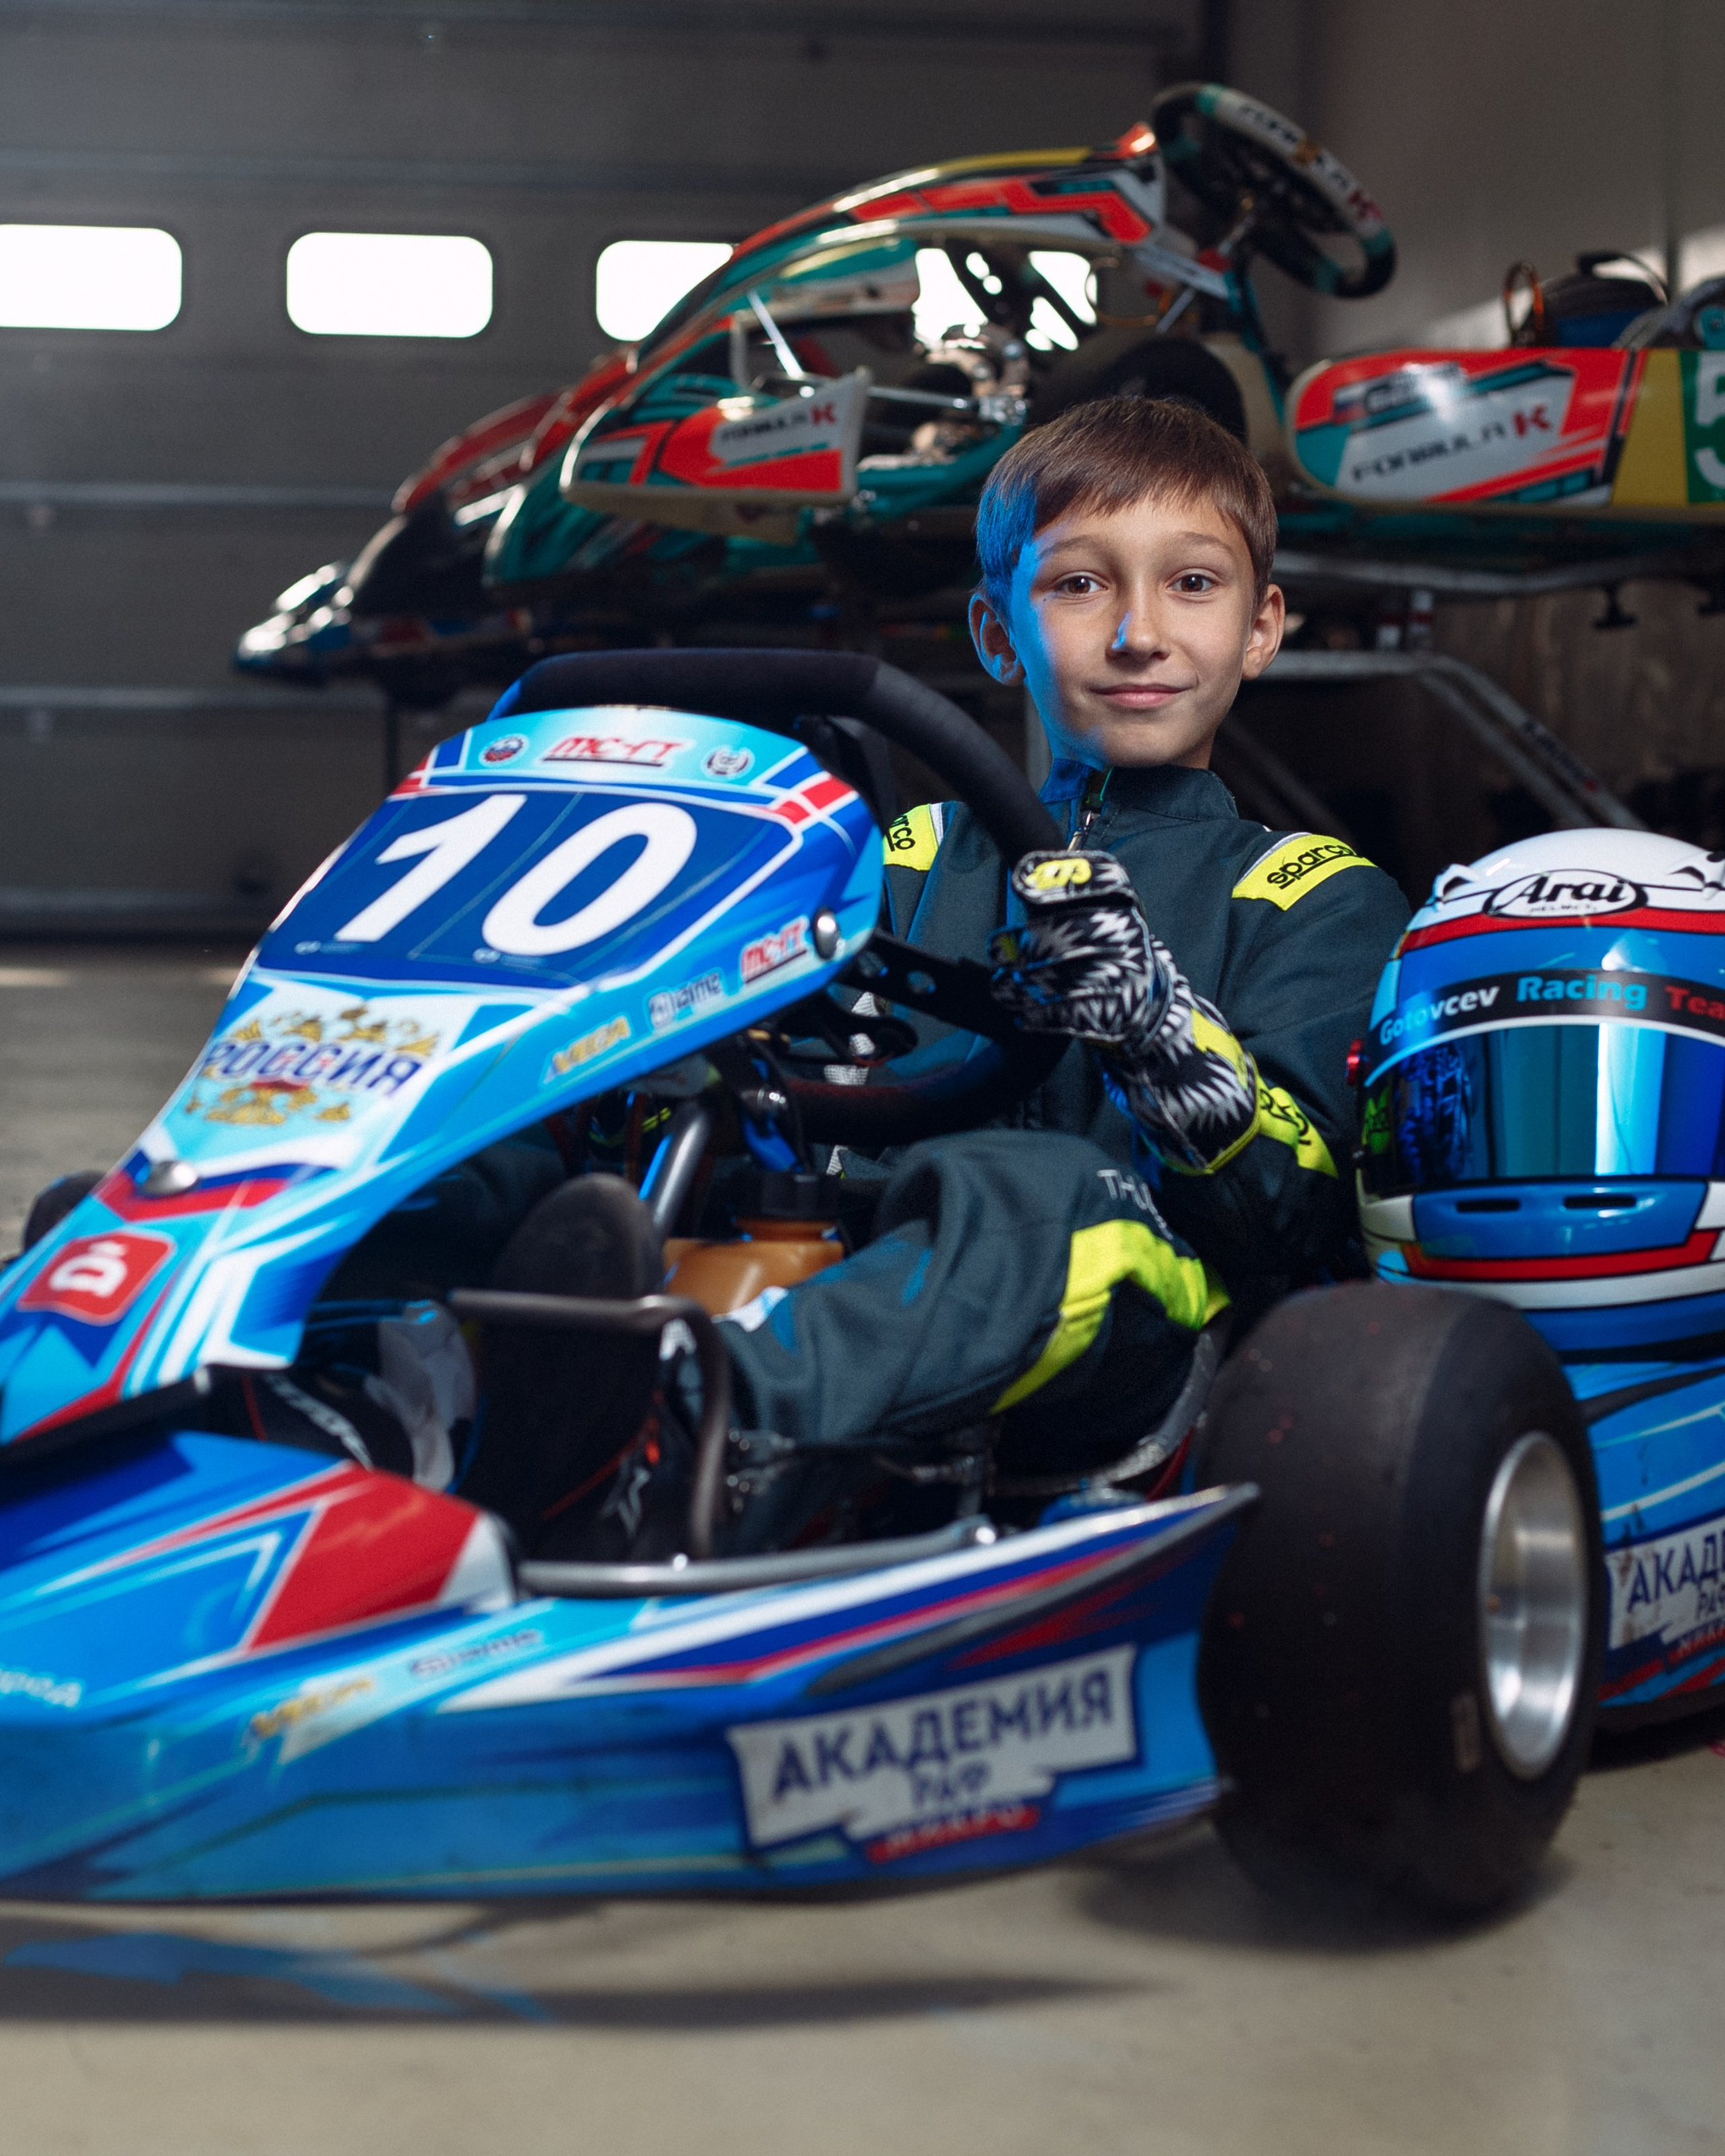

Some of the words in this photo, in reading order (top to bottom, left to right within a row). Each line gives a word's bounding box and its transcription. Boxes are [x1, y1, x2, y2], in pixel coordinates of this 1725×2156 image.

[811, 400, 838, 427] K
[1511, 402, 1552, 440] K
[888, 814, 916, 852] arco
[333, 794, 698, 957] 10
[1498, 876, 1627, 911] Arai
[1516, 974, 1648, 1011] Racing
[1664, 984, 1725, 1021] Tea
[203, 1042, 422, 1100] РОССИЯ
[1625, 1529, 1725, 1614] АКАД
[770, 1668, 1112, 1803] АКАДЕМИЯ
